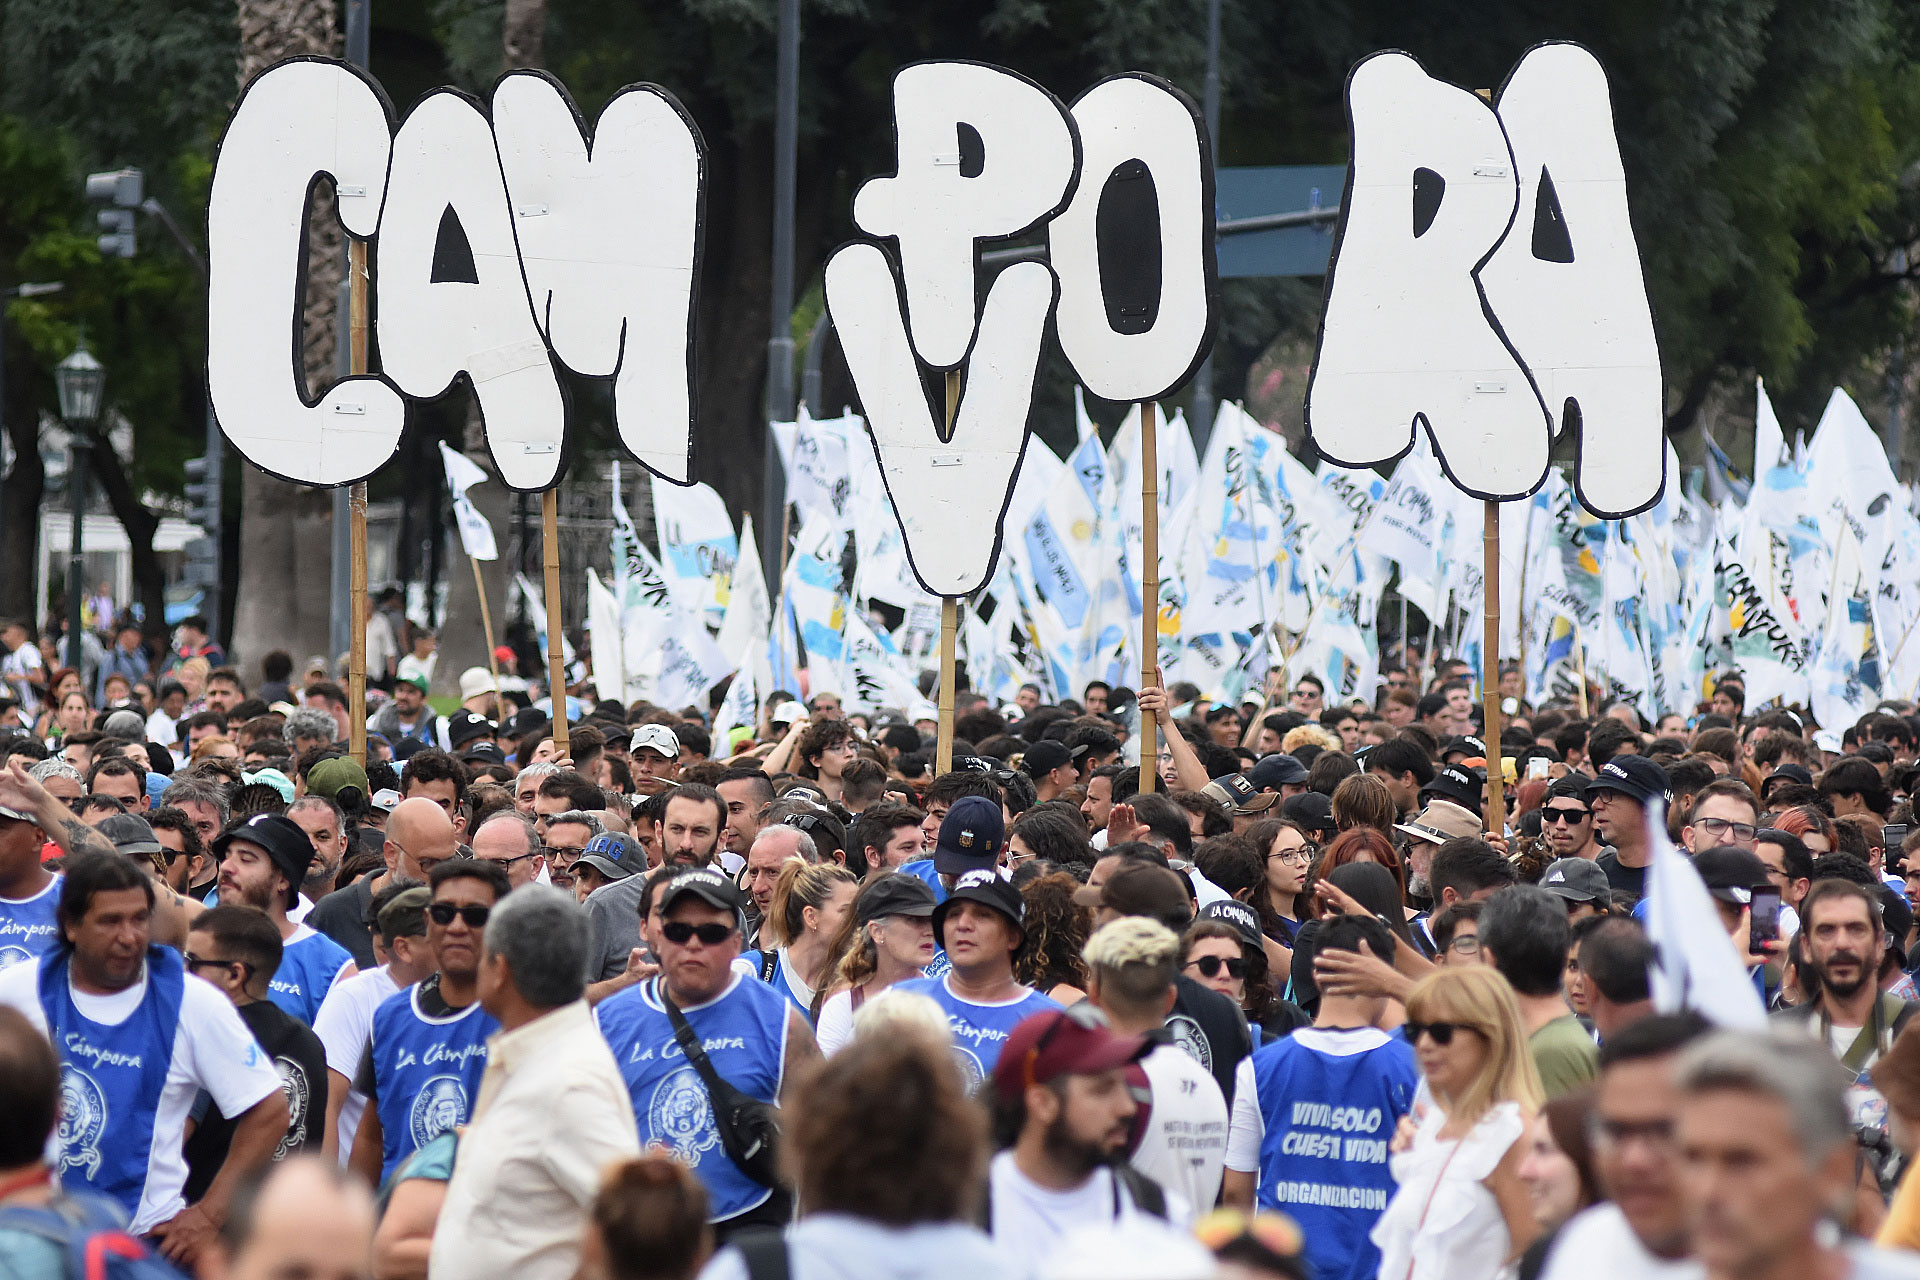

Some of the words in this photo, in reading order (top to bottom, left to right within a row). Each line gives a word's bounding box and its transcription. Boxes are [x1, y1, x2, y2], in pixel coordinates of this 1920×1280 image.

[629, 1042, 655, 1065] La
[1331, 1106, 1382, 1134] SOLO
[1345, 1138, 1387, 1164] VIDA
[1277, 1181, 1387, 1211] ORGANIZACION
